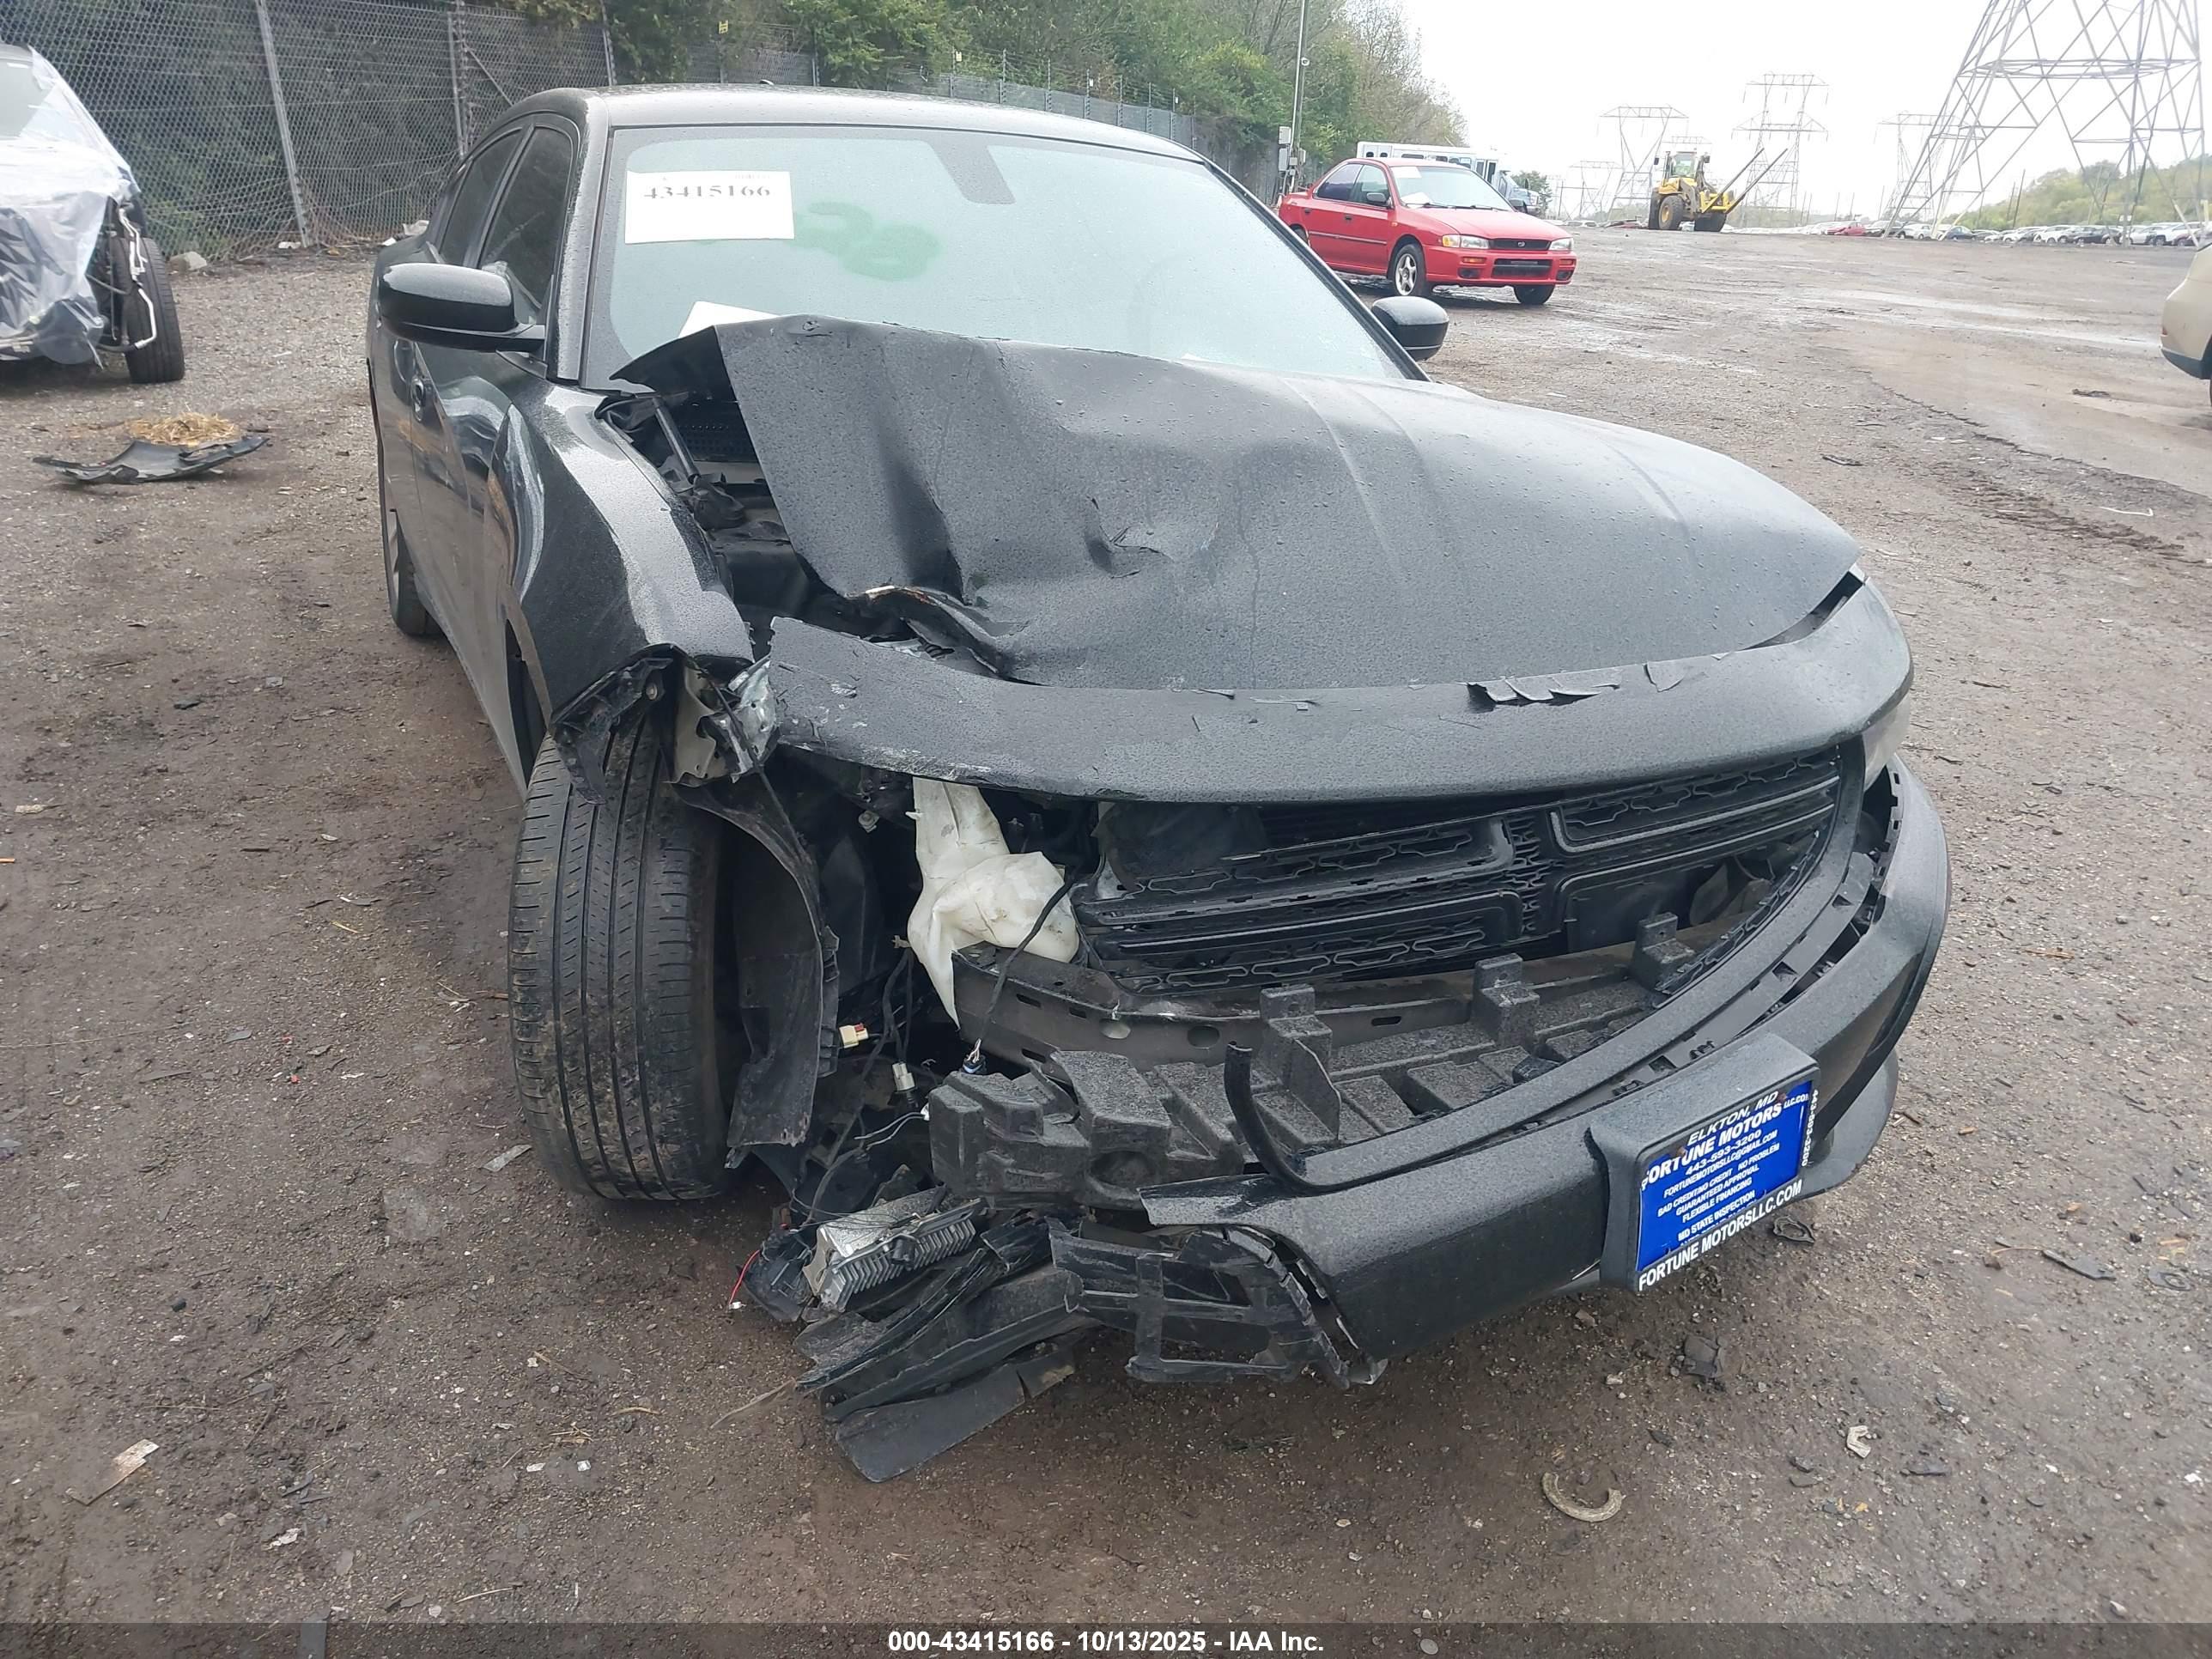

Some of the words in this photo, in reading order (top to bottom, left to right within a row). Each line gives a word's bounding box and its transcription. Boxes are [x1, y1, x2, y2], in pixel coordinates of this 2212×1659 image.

[642, 185, 770, 199] 43415166
[1687, 1105, 1750, 1146] ELKTON,
[1754, 1091, 1779, 1110] MD
[1717, 1103, 1782, 1147] MOTORS
[1686, 1129, 1762, 1176] 443-593-3200
[1657, 1202, 1673, 1218] BAD
[1709, 1167, 1733, 1187] CREDIT
[1737, 1159, 1749, 1171] NO
[1748, 1143, 1780, 1167] PROBLEM
[1675, 1182, 1723, 1216] GUARANTEED
[1723, 1164, 1760, 1190] APPROVAL
[1682, 1197, 1716, 1223] FLEXIBLE
[1716, 1176, 1753, 1205] FINANCING
[1638, 1243, 1700, 1292] FORTUNE
[1701, 1179, 1803, 1254] MOTORSLLC.COM
[1677, 1227, 1691, 1242] MD
[1691, 1212, 1715, 1234] STATE
[1714, 1189, 1755, 1220] INSPECTION
